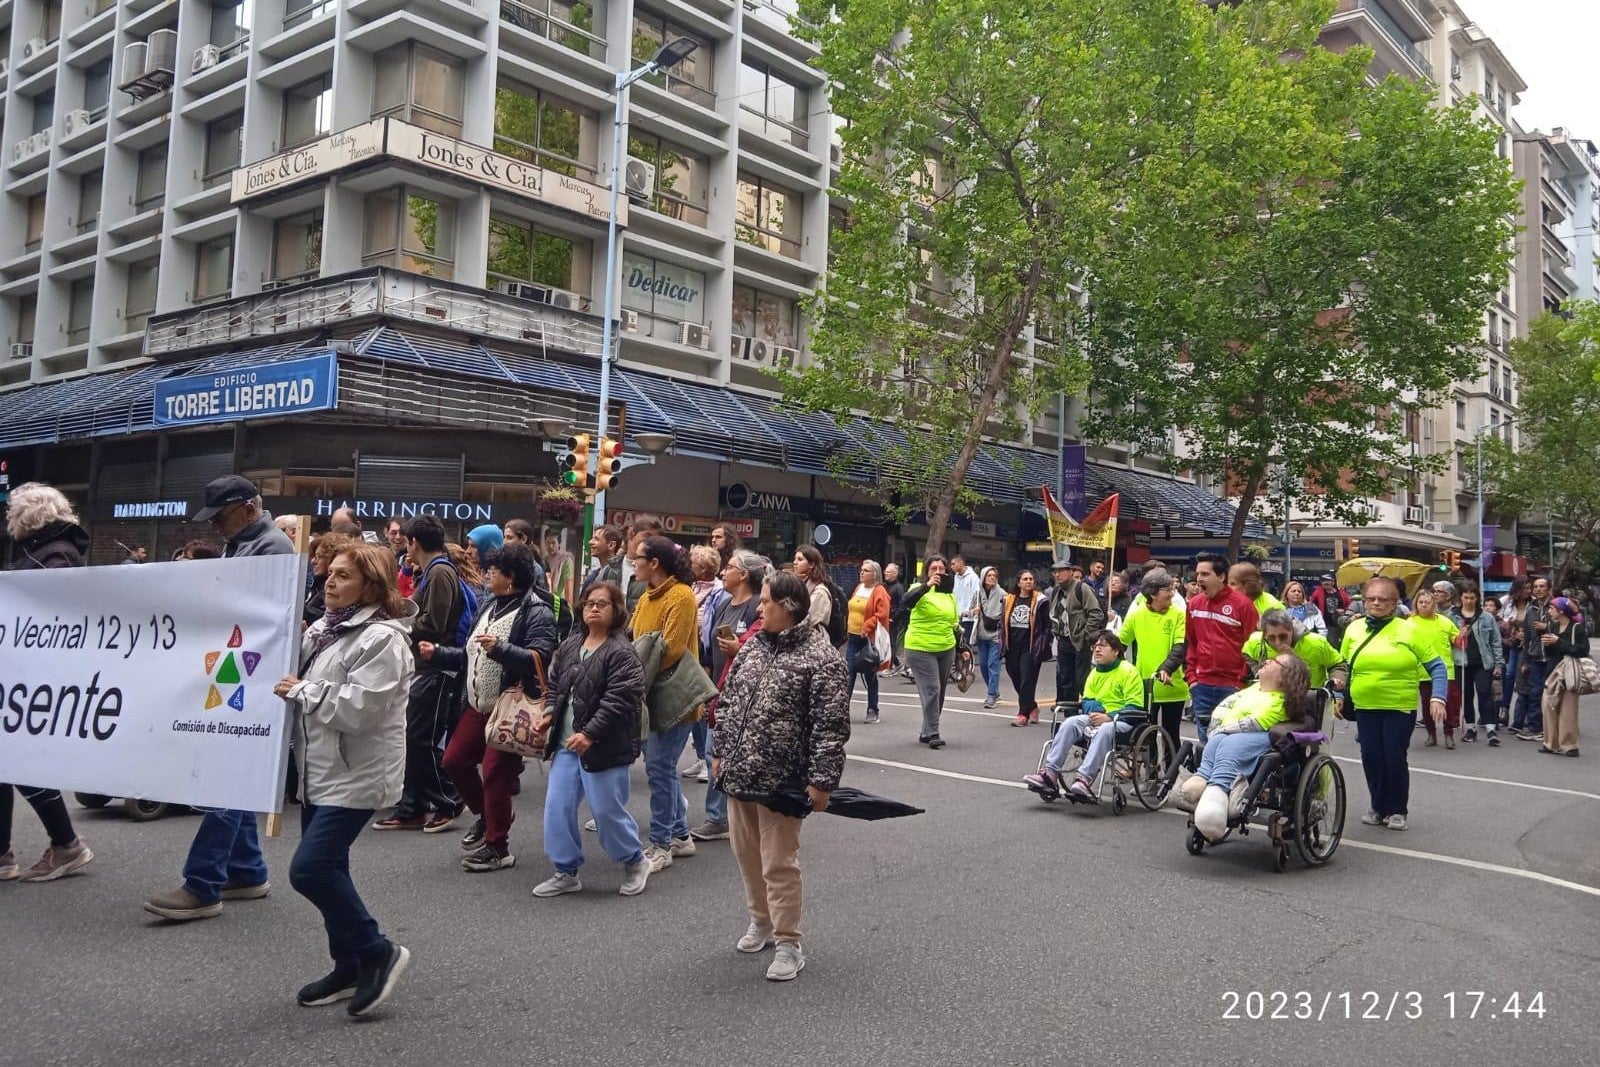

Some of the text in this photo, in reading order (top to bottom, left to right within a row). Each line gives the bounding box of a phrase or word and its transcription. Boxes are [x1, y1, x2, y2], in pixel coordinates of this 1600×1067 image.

[244, 152, 317, 192] Jones & Cia.
[418, 133, 542, 191] Jones & Cia.
[560, 176, 595, 205] Marcas y
[588, 203, 615, 220] Patent
[628, 267, 699, 303] Dedicar
[214, 372, 257, 389] EDIFICIO
[165, 378, 314, 420] TORRE LIBERTAD
[749, 492, 791, 511] CANVA
[14, 615, 88, 649] Vecinal
[97, 615, 121, 650] 12
[124, 623, 141, 659] y
[150, 614, 177, 650] 13
[0, 670, 123, 741] sente
[172, 720, 271, 738] Comisión de Discapacidad
